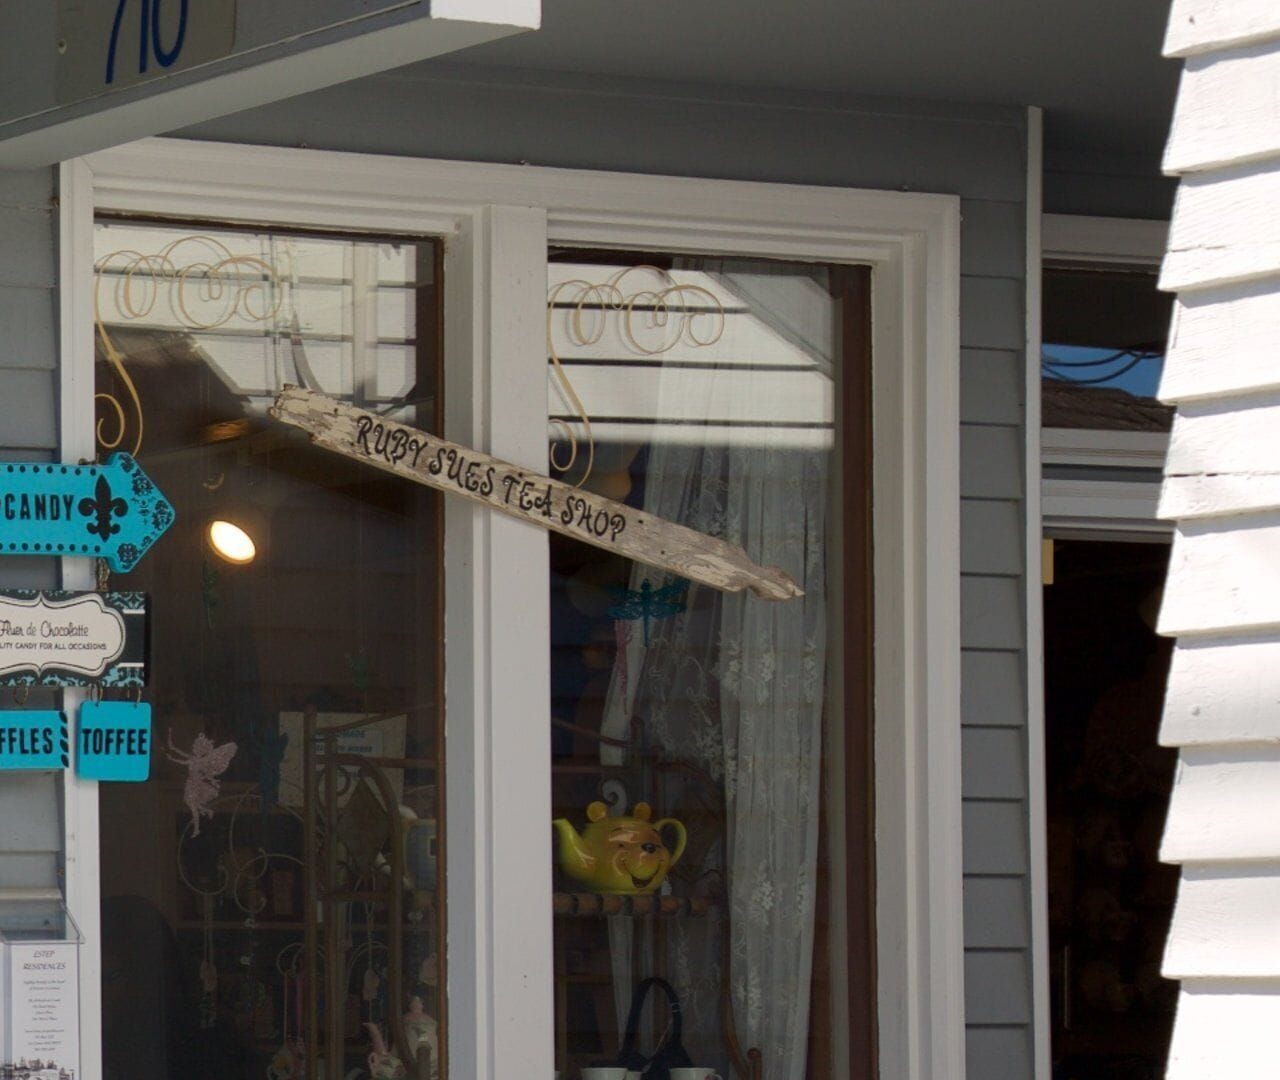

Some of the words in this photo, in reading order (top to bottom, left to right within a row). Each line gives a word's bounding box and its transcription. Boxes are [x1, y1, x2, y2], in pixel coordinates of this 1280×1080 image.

[354, 414, 429, 470] RUBY
[428, 445, 496, 496] SUES
[501, 473, 554, 519] TEA
[560, 495, 627, 543] SHOP
[3, 493, 76, 523] CANDY
[26, 622, 37, 637] de
[81, 727, 149, 756] TOFFEE
